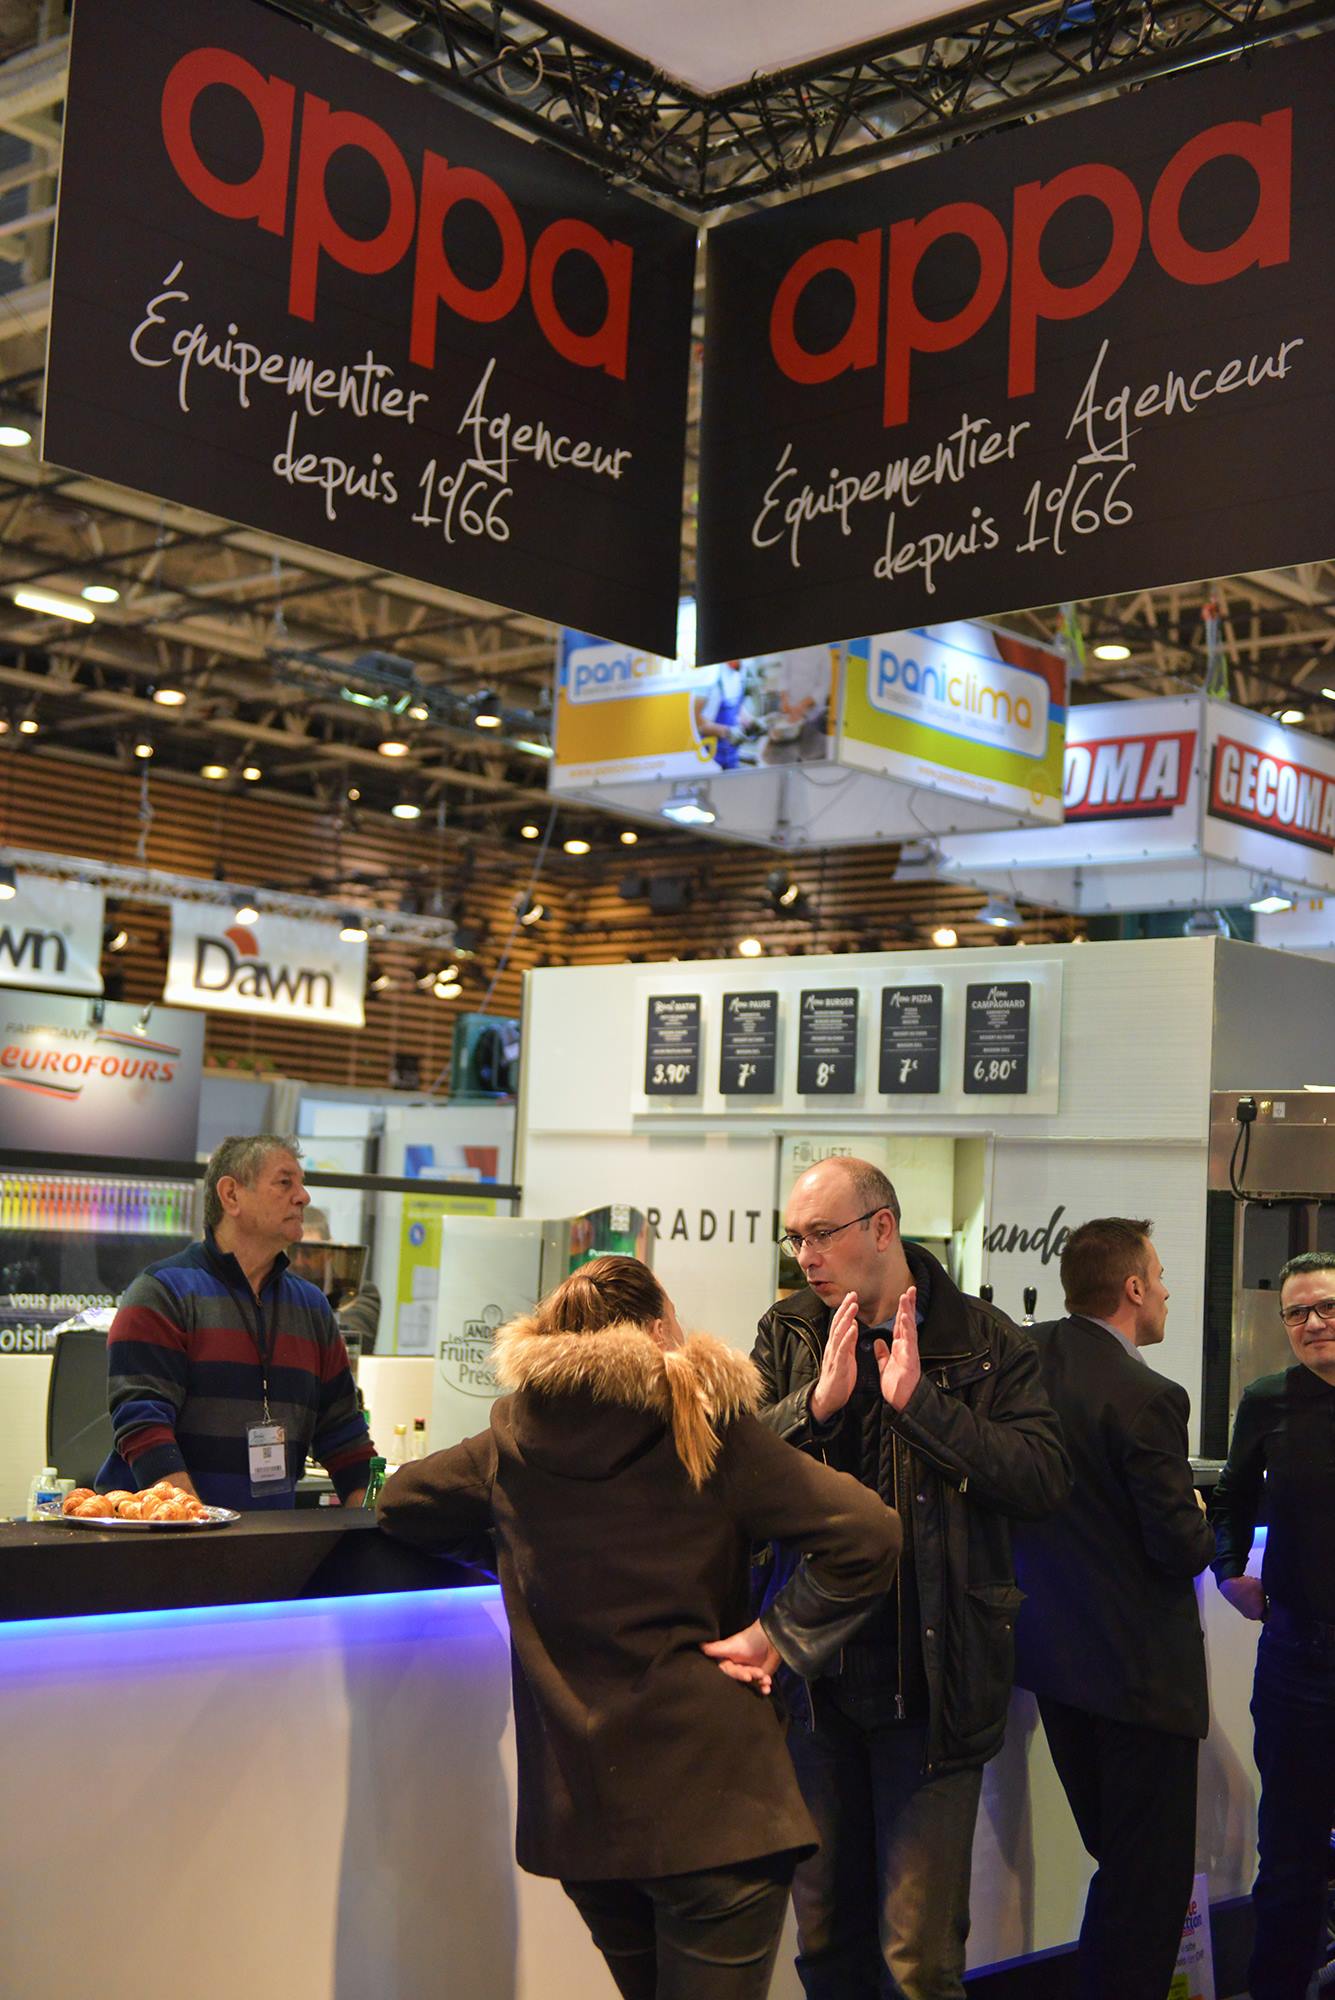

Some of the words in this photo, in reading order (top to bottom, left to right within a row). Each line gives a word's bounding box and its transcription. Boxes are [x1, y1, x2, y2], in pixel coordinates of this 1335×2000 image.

[161, 46, 634, 381] appa
[769, 107, 1293, 428] appa
[129, 260, 429, 424] Équipementier
[456, 358, 633, 483] Agenceur
[273, 410, 399, 520] depuis
[412, 459, 513, 544] 1966
[751, 413, 1031, 567] Équipementier
[1065, 339, 1304, 464] Agenceur
[874, 505, 1000, 594] depuis
[1016, 463, 1137, 555] 1966
[878, 649, 1032, 730] paniclima
[194, 934, 334, 1008] Dawn
[911, 994, 933, 1004] PIZZA
[440, 1341, 485, 1365] Fruits
